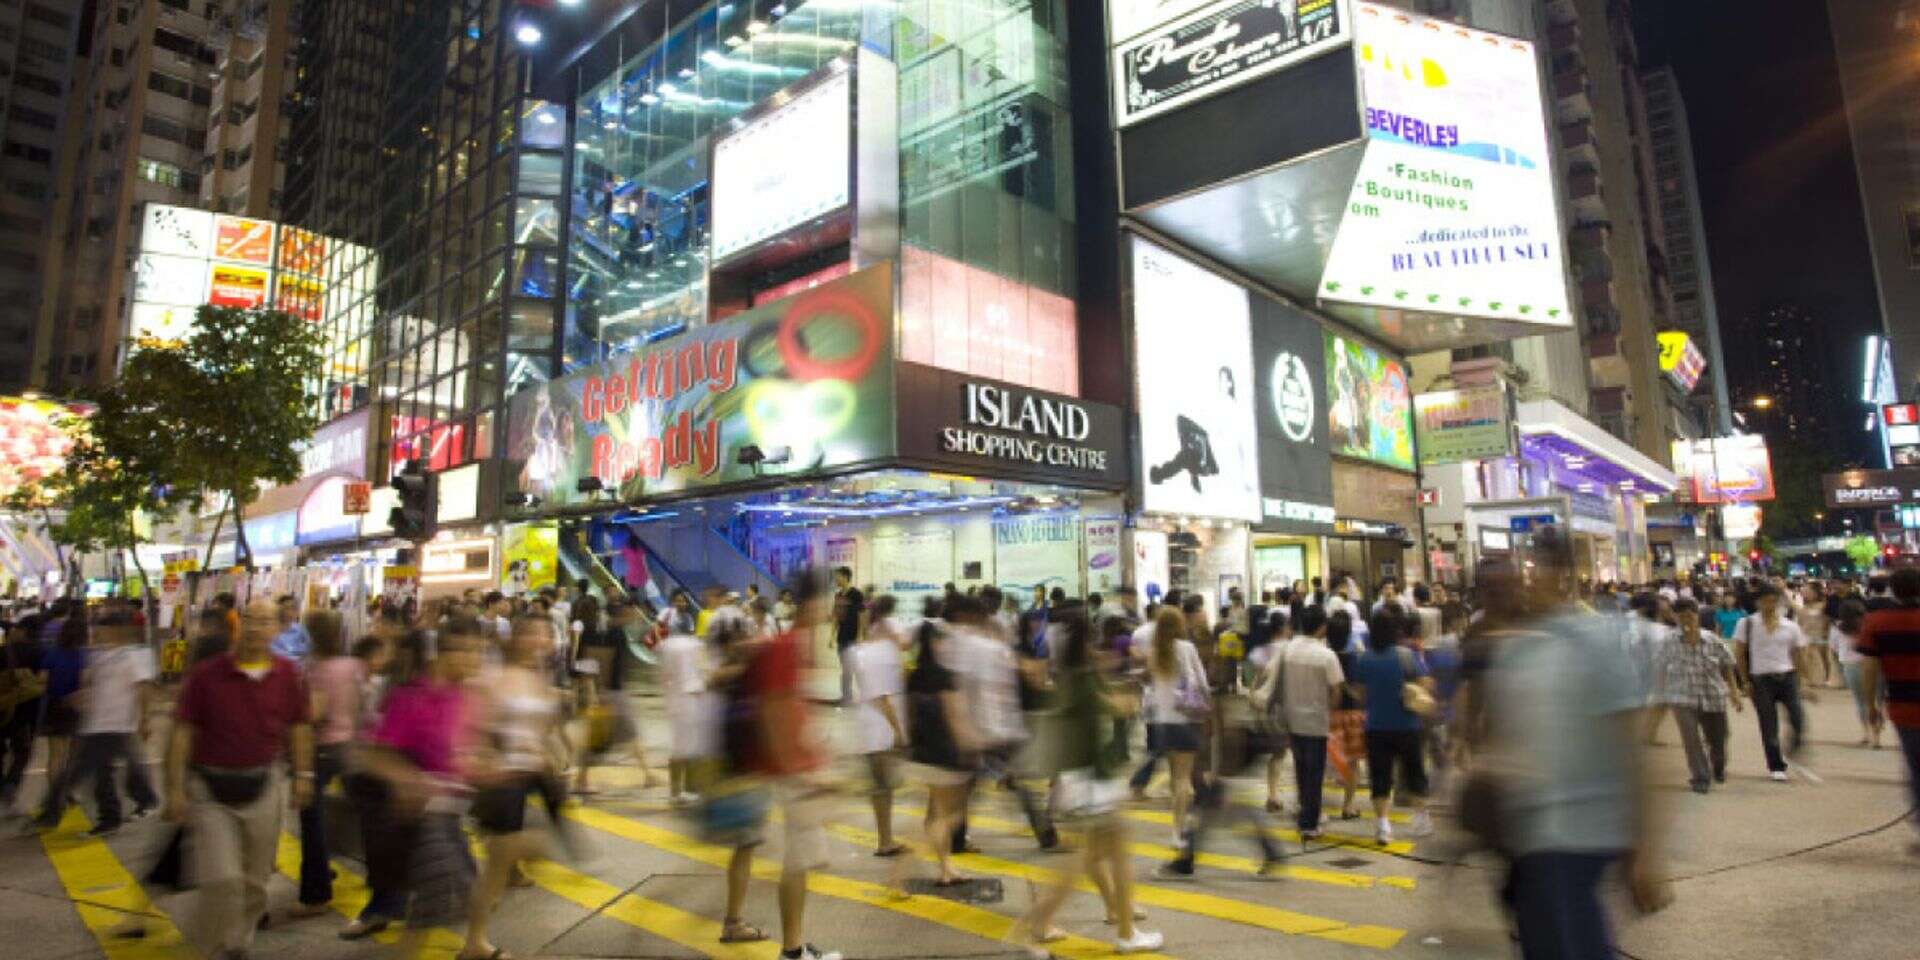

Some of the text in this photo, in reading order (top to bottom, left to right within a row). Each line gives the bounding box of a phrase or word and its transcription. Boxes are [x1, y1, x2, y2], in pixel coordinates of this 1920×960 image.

[582, 338, 738, 422] Getting
[966, 382, 1090, 441] ISLAND
[591, 409, 722, 482] Ready
[943, 427, 1107, 470] SHOPPING CENTRE
